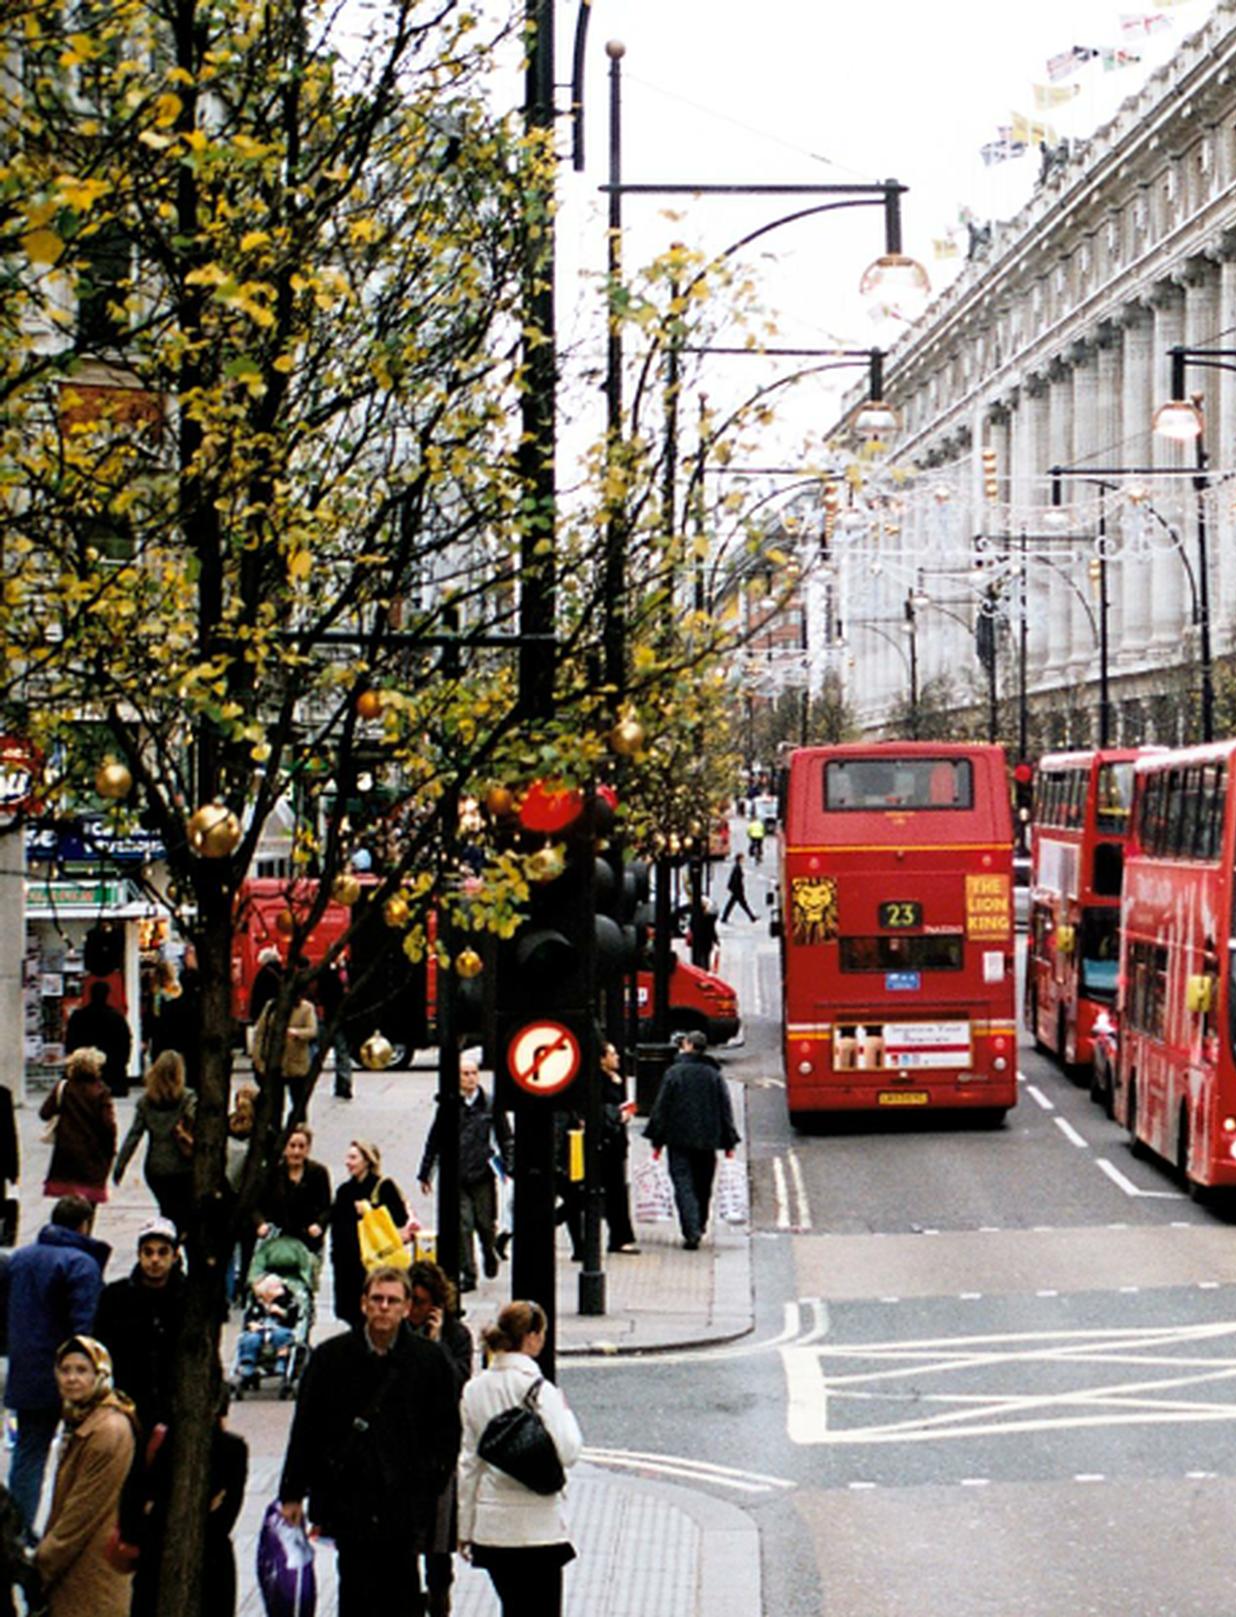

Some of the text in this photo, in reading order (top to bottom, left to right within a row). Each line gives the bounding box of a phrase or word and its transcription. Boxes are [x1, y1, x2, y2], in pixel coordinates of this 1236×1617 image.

[972, 878, 1002, 894] THE
[967, 896, 1008, 912] LION
[886, 903, 916, 926] 23
[967, 914, 1009, 930] KING
